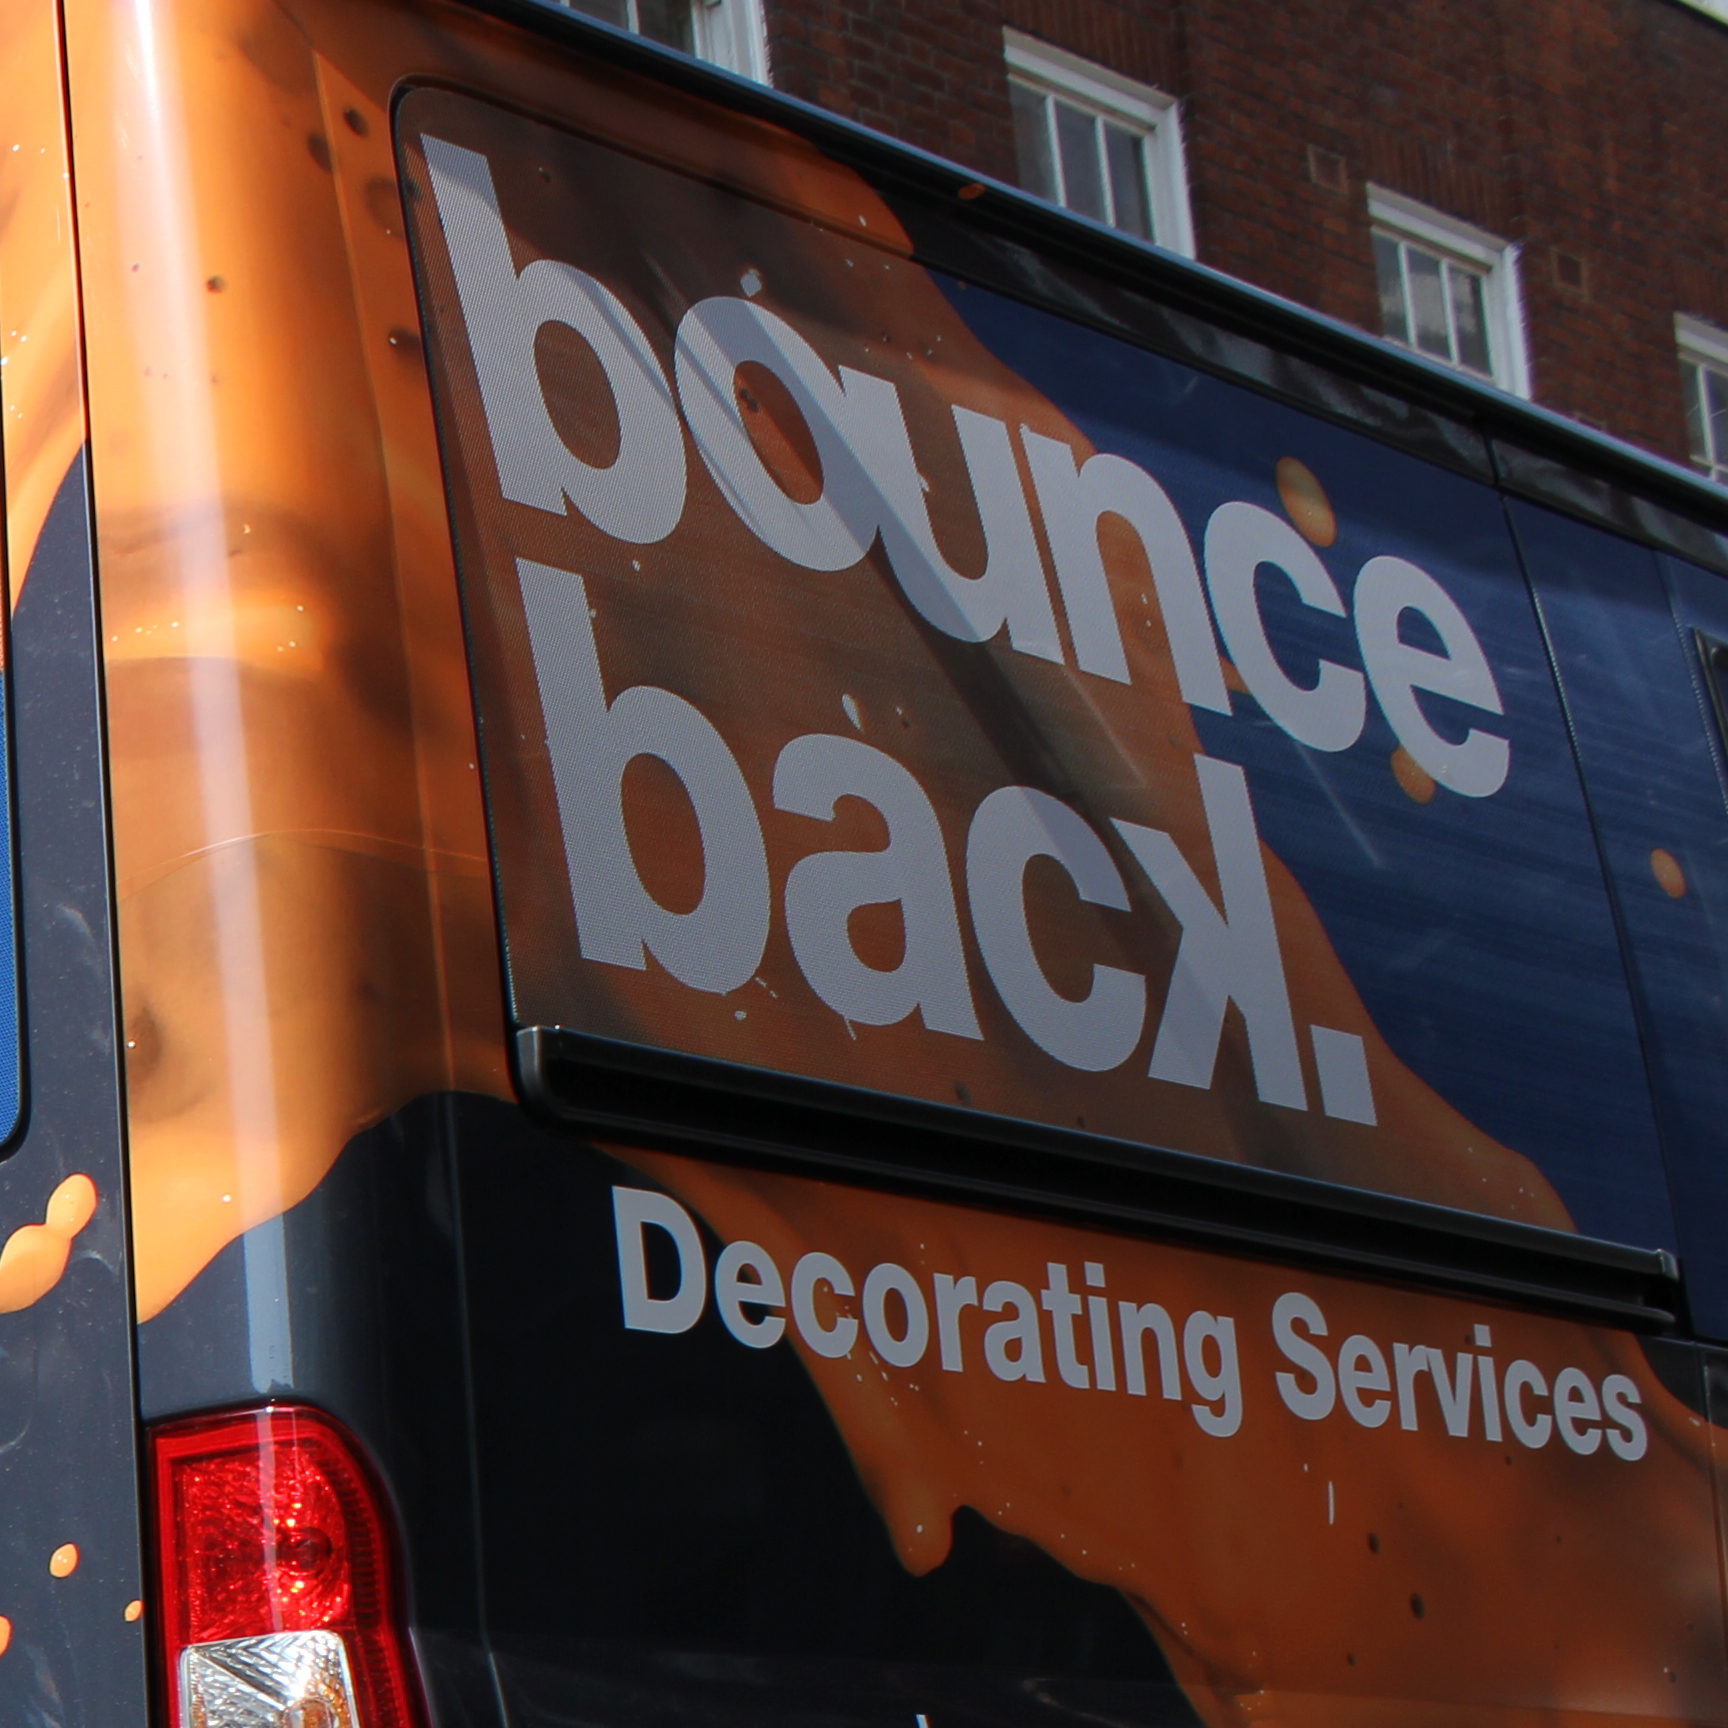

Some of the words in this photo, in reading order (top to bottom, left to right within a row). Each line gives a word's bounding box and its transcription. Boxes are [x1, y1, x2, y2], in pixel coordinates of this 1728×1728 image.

[420, 133, 1511, 797] bounce
[610, 1185, 1243, 1437] Decorating
[1270, 1292, 1648, 1461] Services
